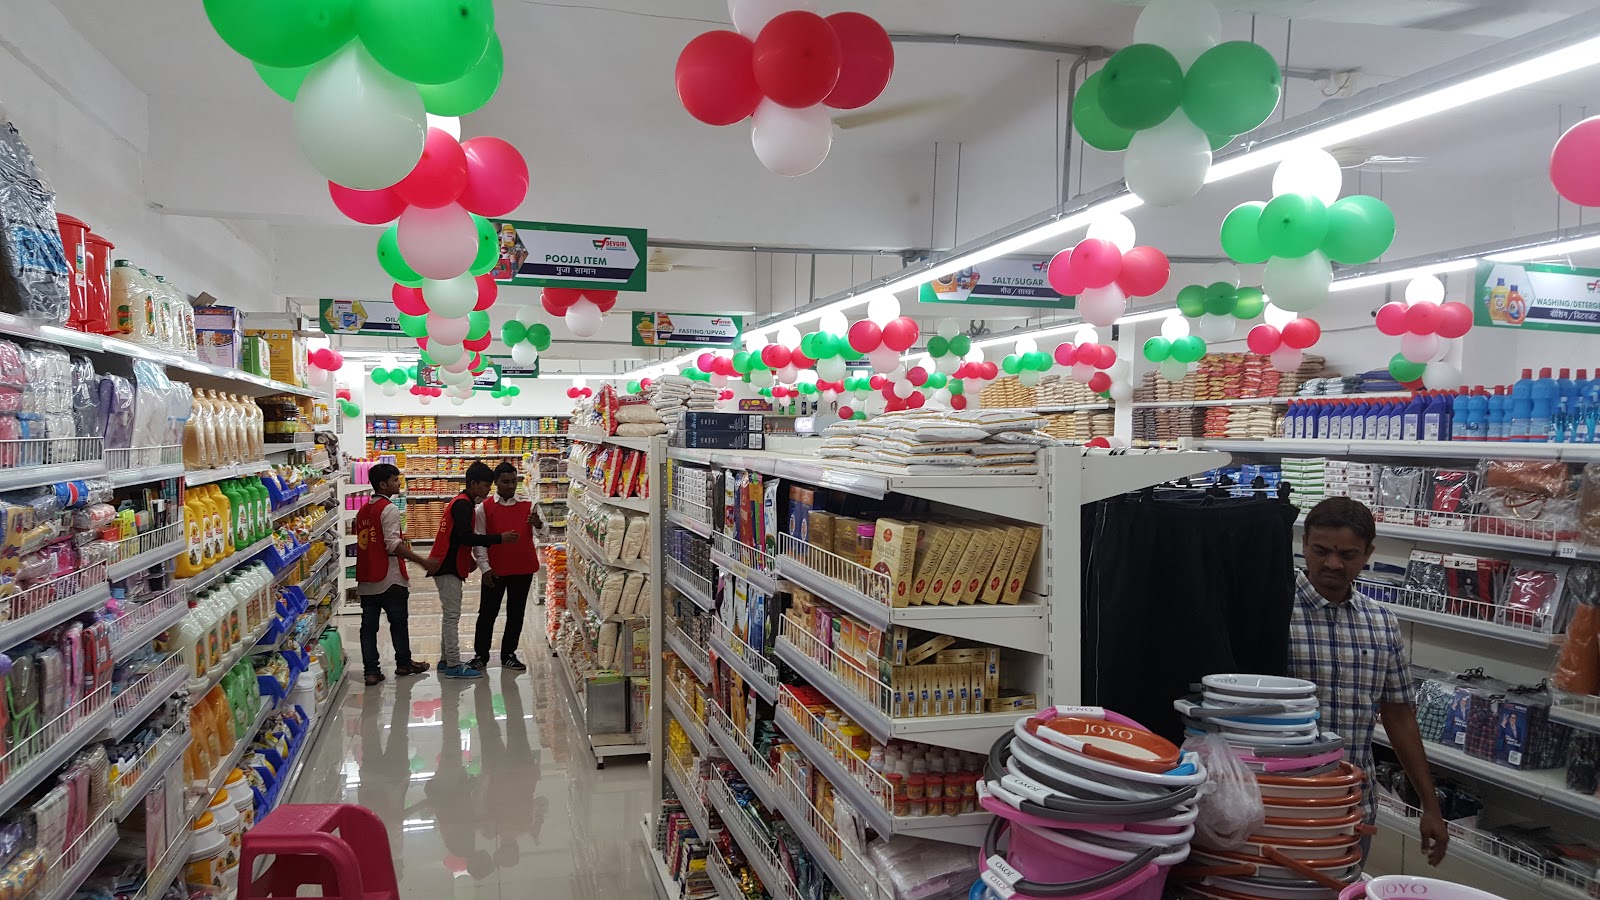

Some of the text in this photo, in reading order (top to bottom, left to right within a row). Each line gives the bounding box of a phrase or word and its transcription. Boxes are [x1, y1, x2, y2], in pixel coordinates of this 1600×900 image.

[545, 254, 607, 265] POOJA ITEM
[556, 266, 597, 276] पुजा सामान
[991, 276, 1044, 286] SALT/SUGAR
[678, 328, 727, 336] FASTING/UPVAS
[1562, 547, 1574, 555] 137
[1084, 723, 1133, 740] JOYO
[995, 861, 1015, 877] JOYO
[1381, 882, 1428, 897] JOYO
